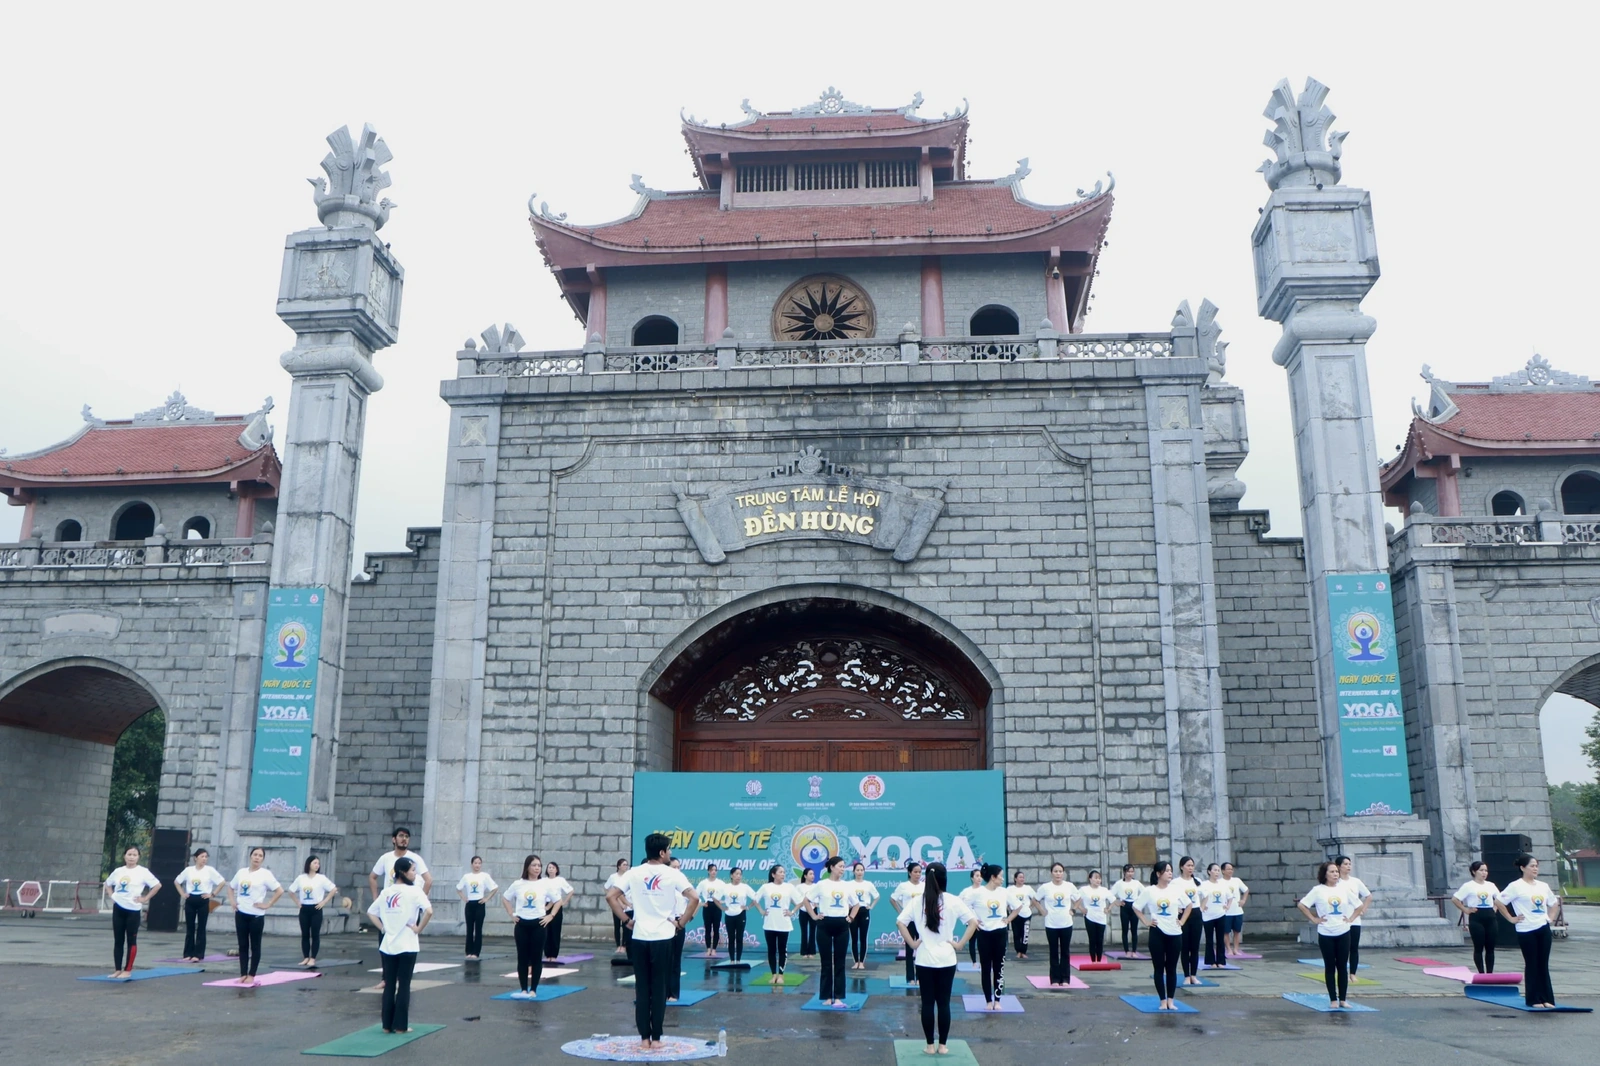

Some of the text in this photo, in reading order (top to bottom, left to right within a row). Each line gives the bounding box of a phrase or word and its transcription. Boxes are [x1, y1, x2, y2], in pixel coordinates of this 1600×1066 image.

[735, 484, 880, 510] TRUNG TÂM LỄ HỘI
[744, 505, 875, 537] ĐỀN HÙNG
[1361, 672, 1384, 685] QUỐC
[1385, 671, 1397, 684] TẾ
[262, 705, 308, 719] YOGA
[1343, 702, 1397, 717] YOGA
[697, 824, 745, 852] QUỐC
[748, 824, 776, 850] TẾ
[849, 835, 976, 869] YOGA
[735, 859, 756, 871] DAY
[758, 859, 776, 871] OF
[21, 887, 40, 897] STOP
